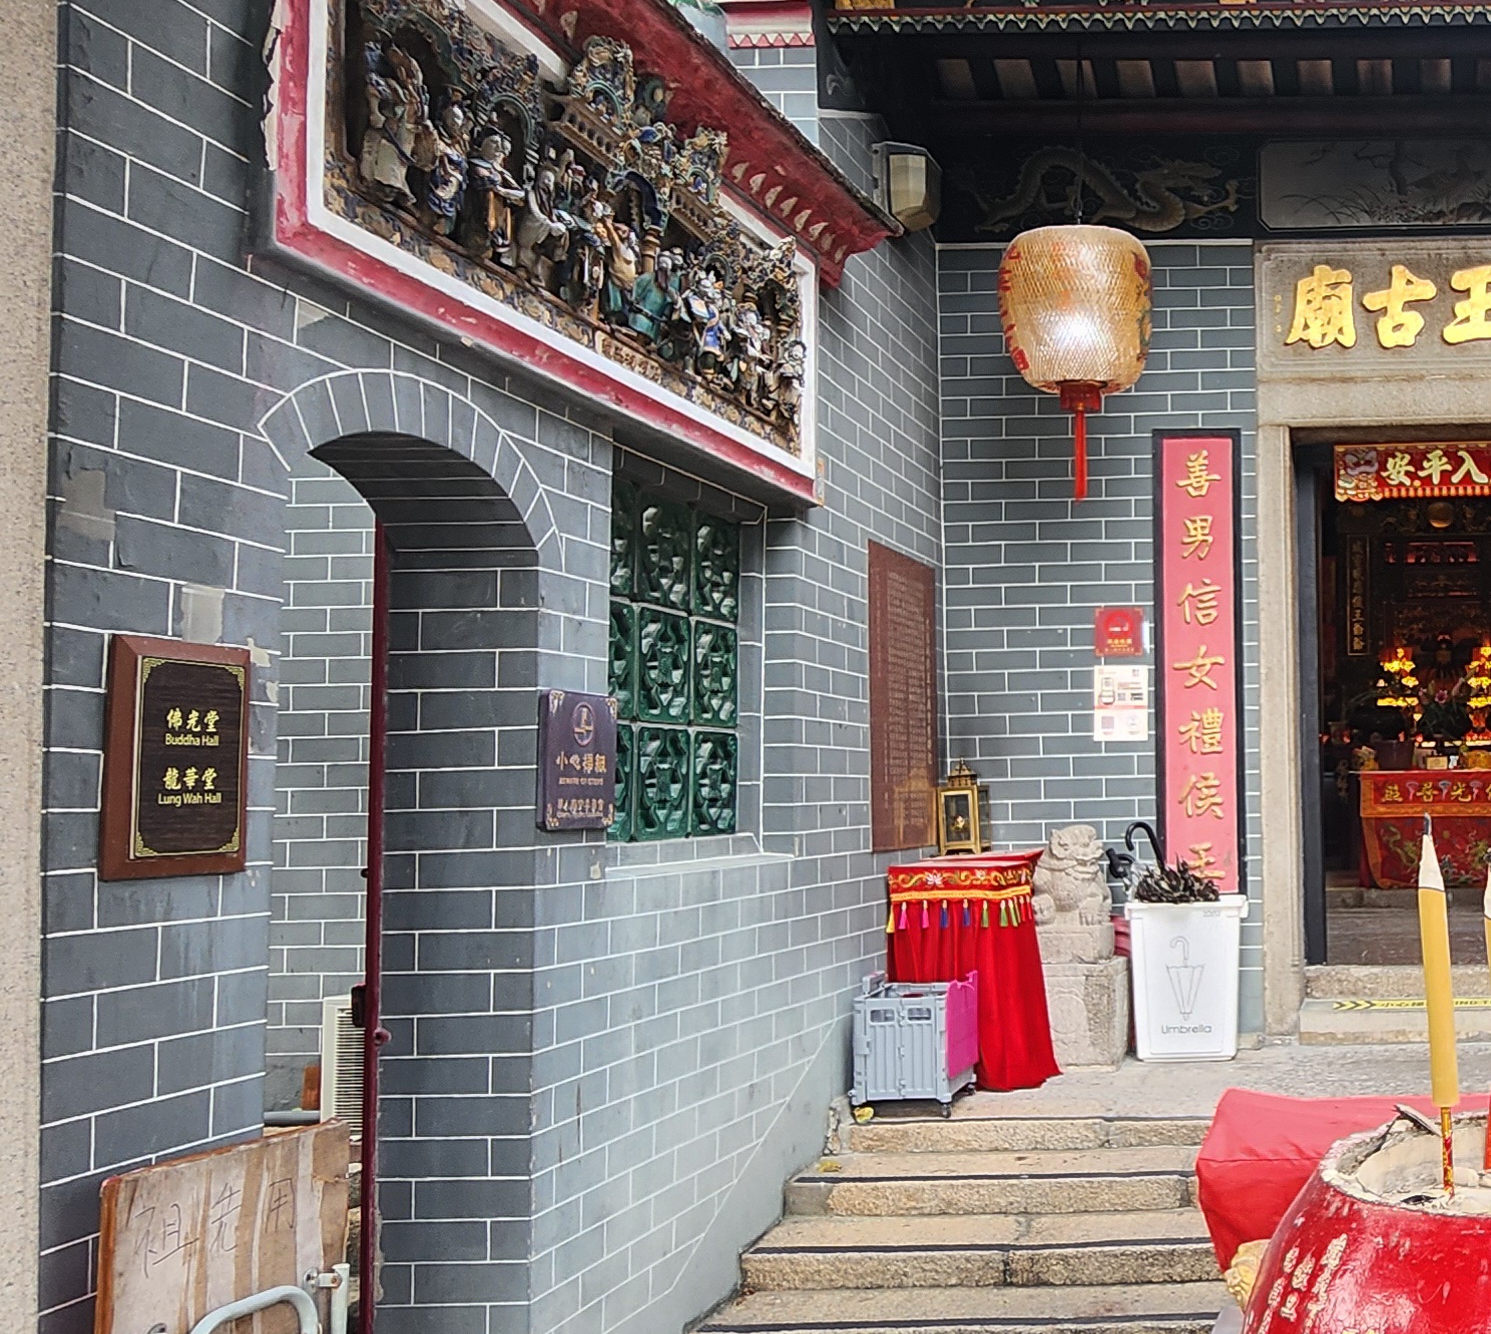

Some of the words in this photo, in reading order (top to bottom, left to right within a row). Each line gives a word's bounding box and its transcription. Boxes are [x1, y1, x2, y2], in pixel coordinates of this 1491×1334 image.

[1173, 450, 1227, 886] 善男信女禮侯王
[166, 707, 220, 732] 佛光堂
[165, 733, 201, 746] Buddha
[201, 735, 219, 746] Hall
[555, 751, 607, 774] 小心梯級
[163, 766, 218, 790] 龍華堂
[158, 793, 182, 807] Lung
[182, 792, 203, 804] Wah
[203, 792, 222, 804] Hall
[1161, 1023, 1213, 1035] Umbrella
